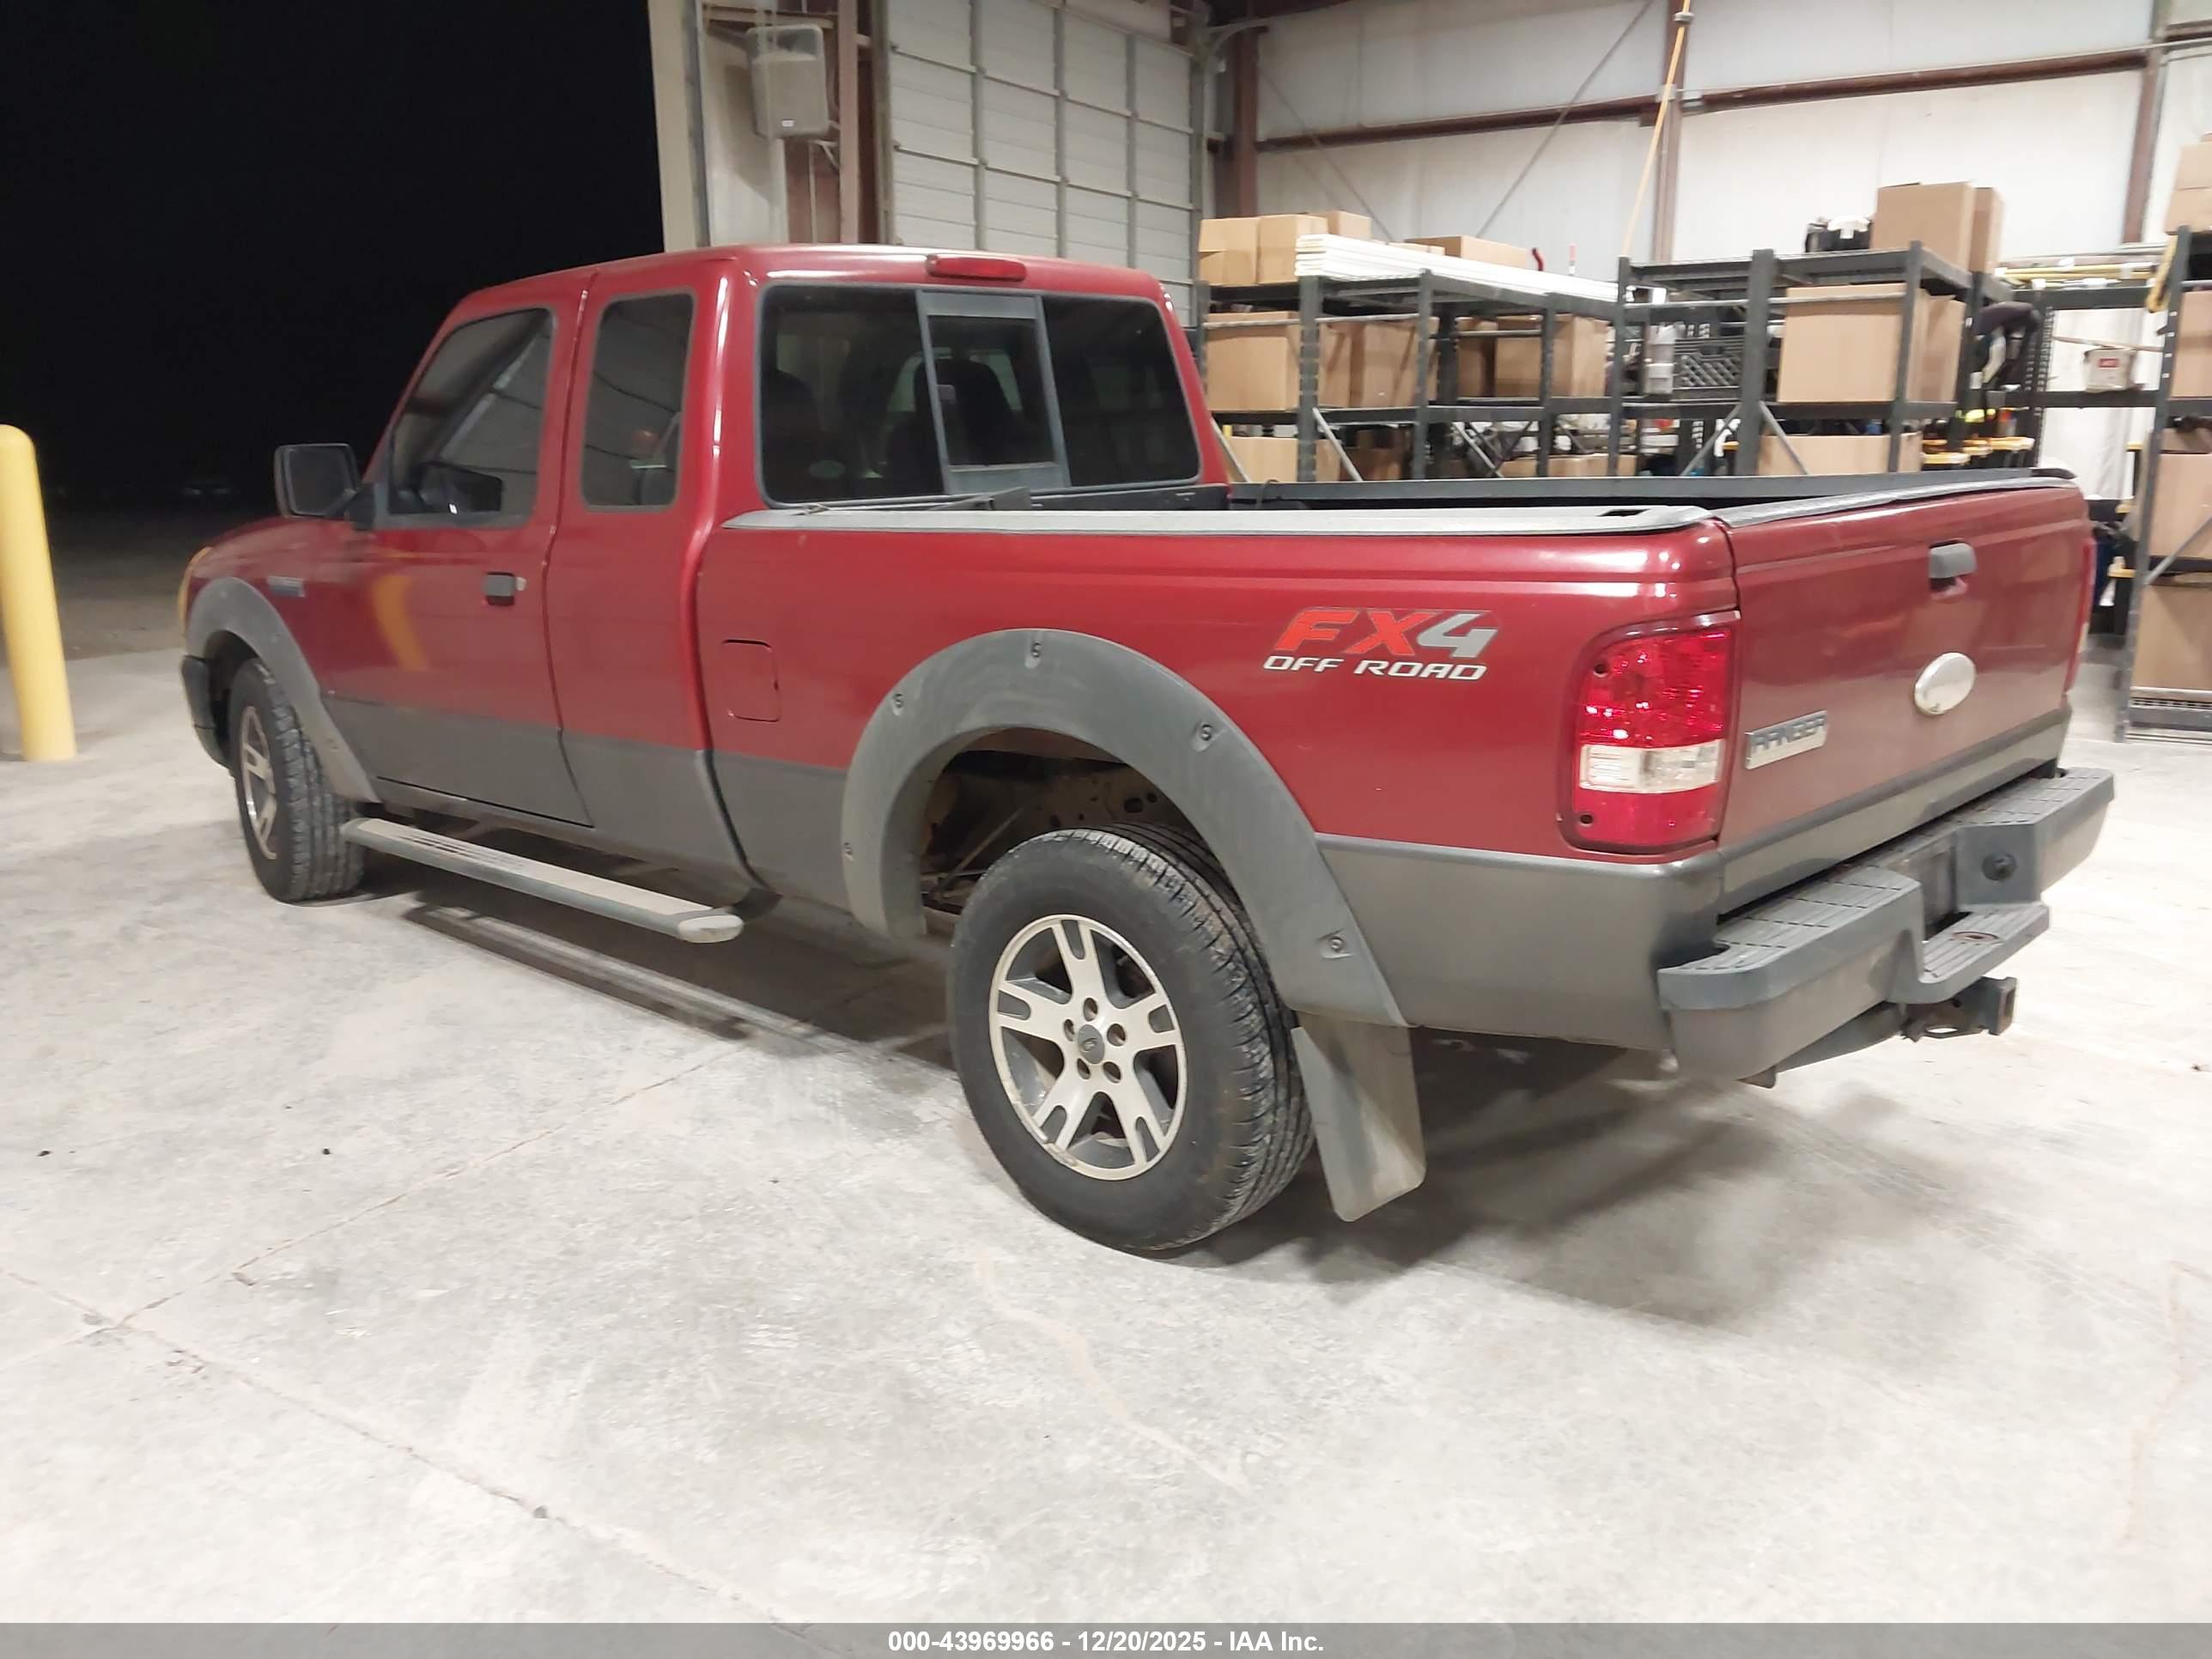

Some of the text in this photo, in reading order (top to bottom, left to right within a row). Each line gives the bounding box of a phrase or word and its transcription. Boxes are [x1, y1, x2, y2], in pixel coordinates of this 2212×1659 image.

[1273, 609, 1498, 659] FX4
[1263, 654, 1488, 681] OFF ROAD
[1750, 714, 1826, 755] RANGER
